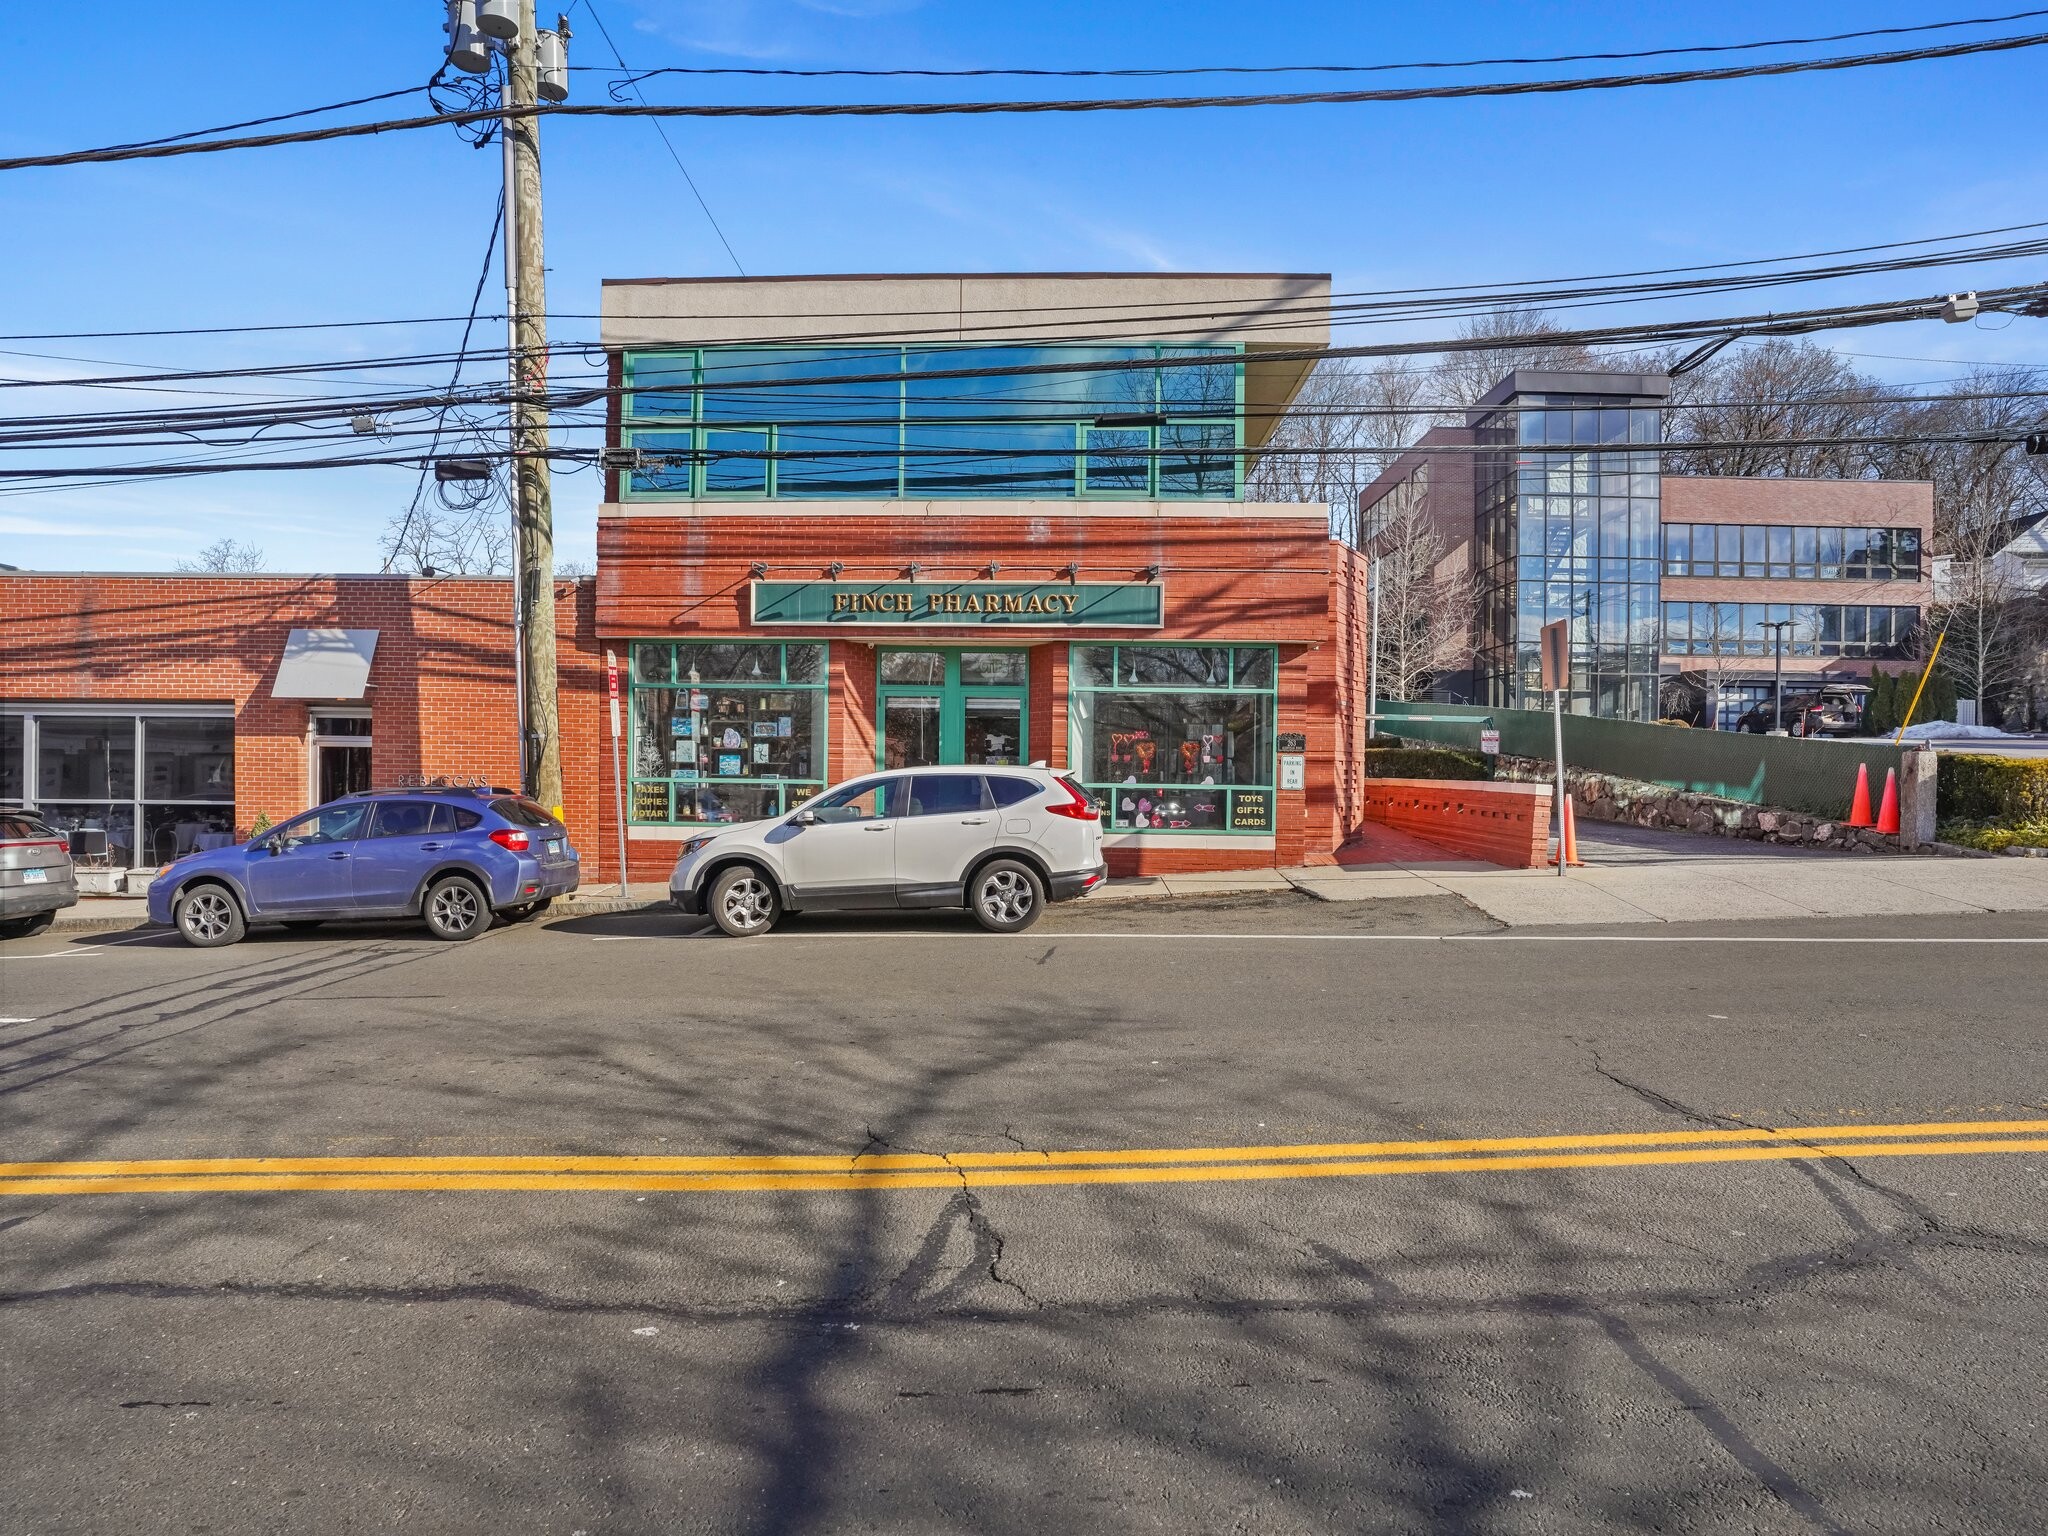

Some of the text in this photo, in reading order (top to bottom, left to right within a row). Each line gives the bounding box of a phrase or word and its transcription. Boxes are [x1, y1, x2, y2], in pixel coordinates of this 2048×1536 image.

[832, 593, 1079, 613] FINCH PHARMACY
[398, 774, 488, 787] REBECCAS
[636, 785, 666, 793] FAXES
[796, 788, 811, 796] WE
[633, 797, 669, 806] COPIES
[632, 810, 669, 818] NOTARY
[1236, 806, 1265, 814] GIFTS
